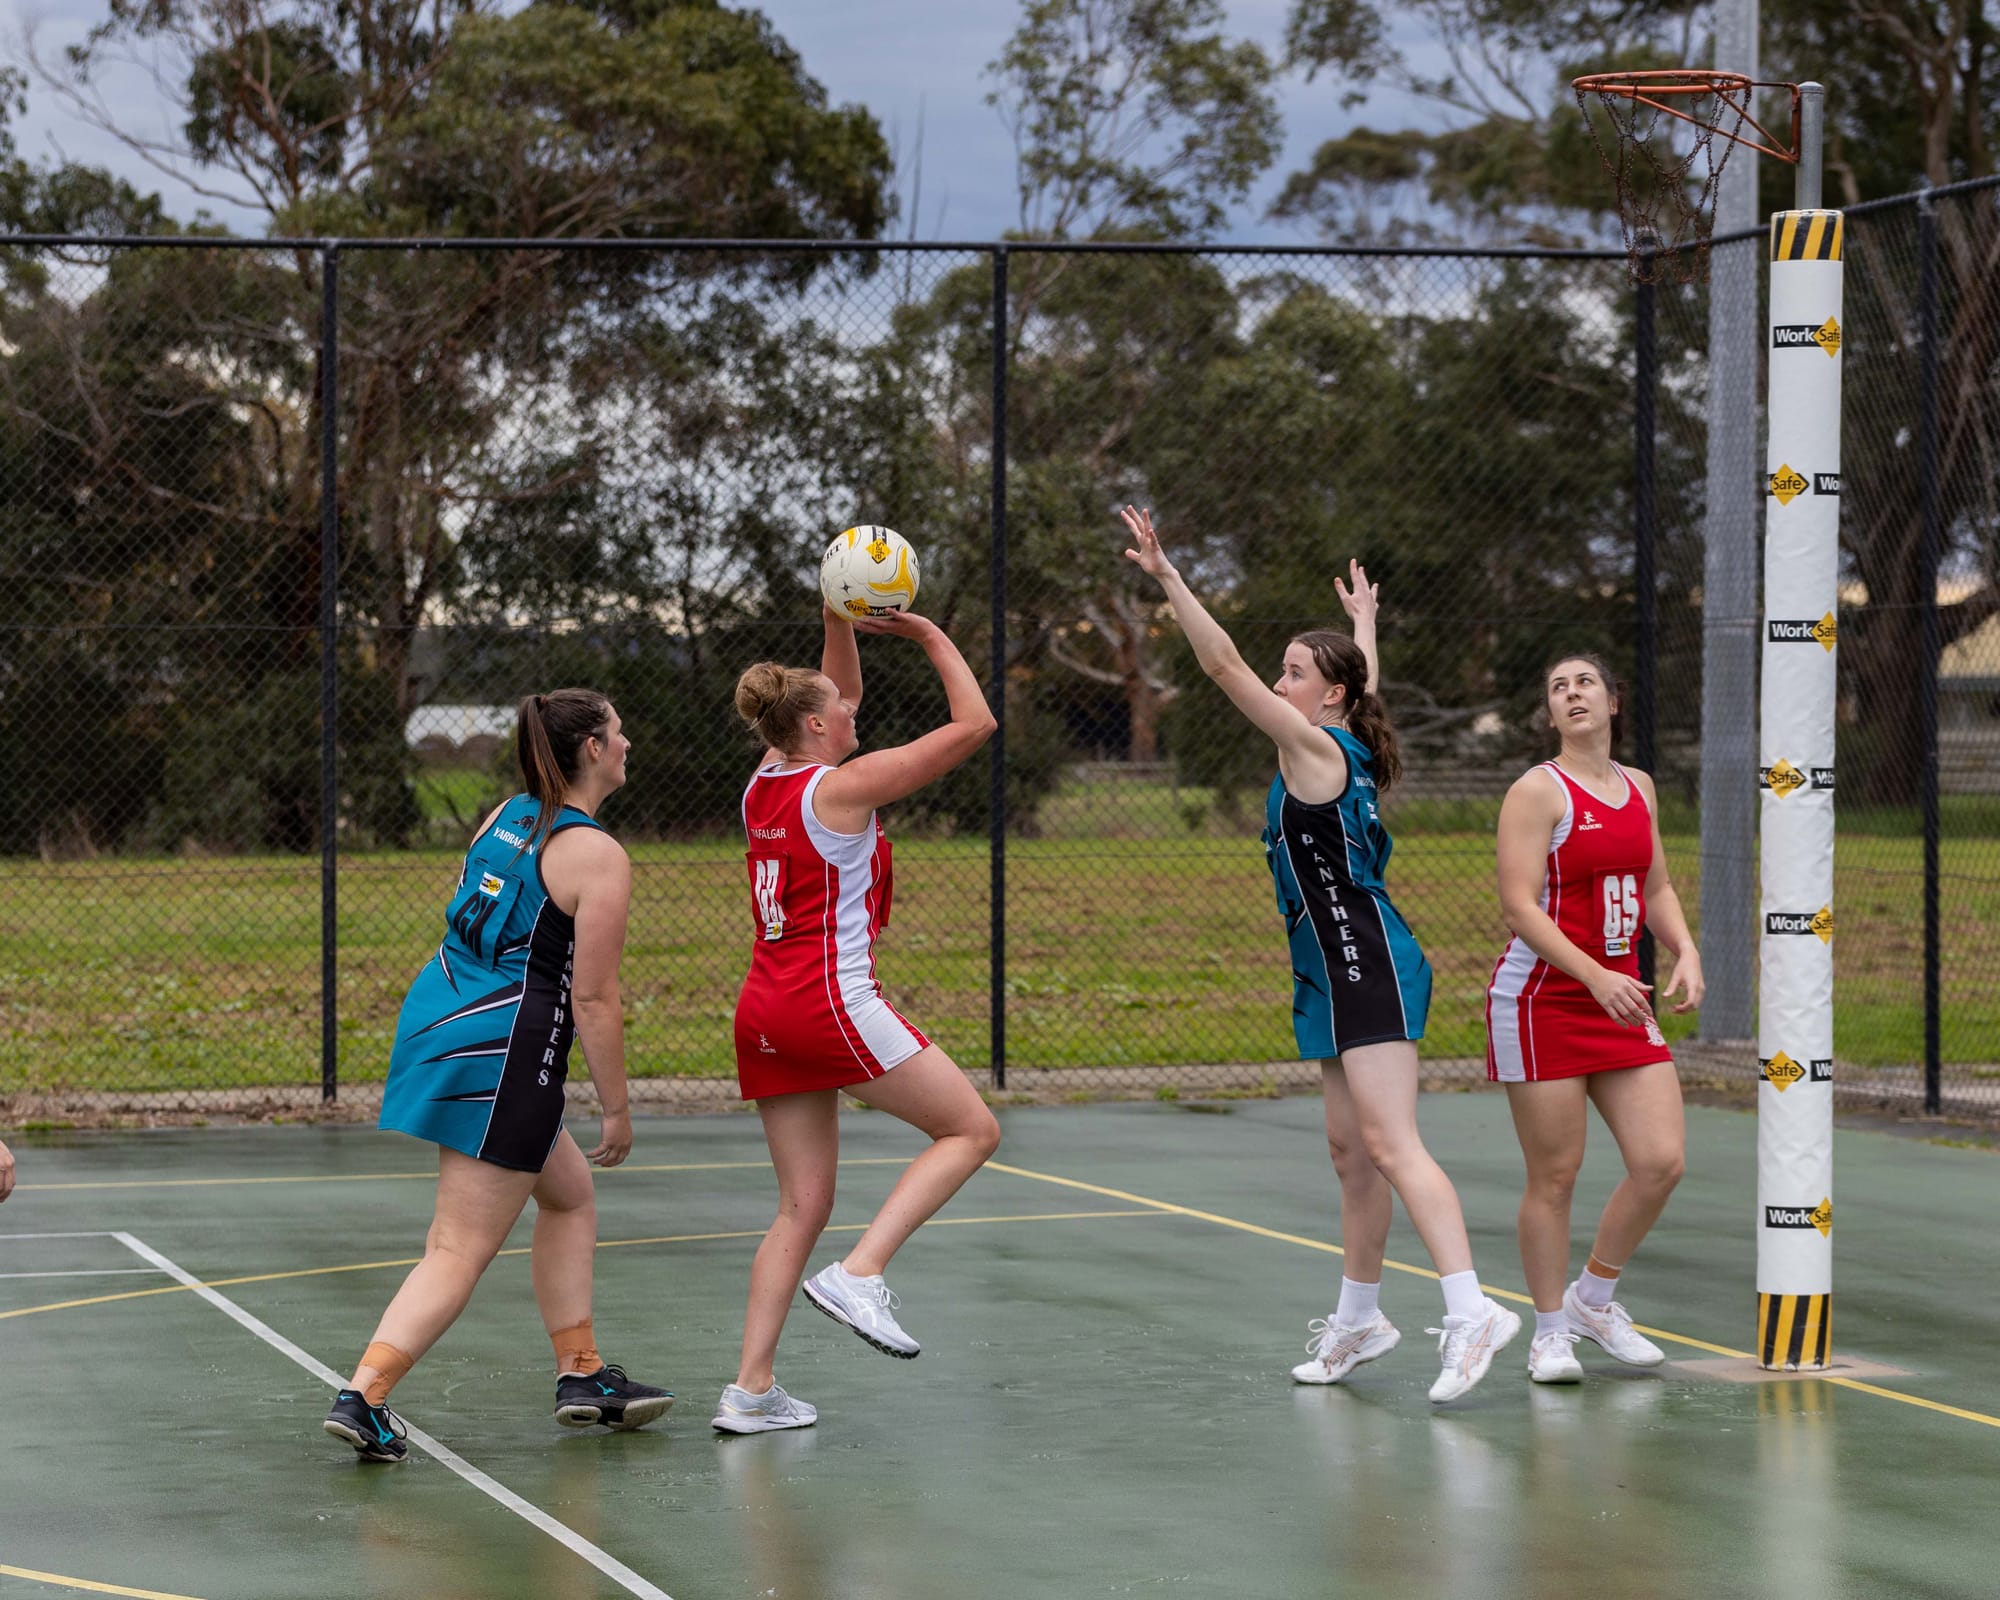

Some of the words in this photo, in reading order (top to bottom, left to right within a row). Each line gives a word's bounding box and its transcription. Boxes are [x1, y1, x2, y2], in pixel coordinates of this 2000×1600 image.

[1773, 475, 1801, 490] Safe
[1770, 770, 1799, 784] Safe
[493, 826, 536, 856] YARRAGN
[1603, 874, 1640, 938] GS
[1768, 1062, 1798, 1077] Safe
